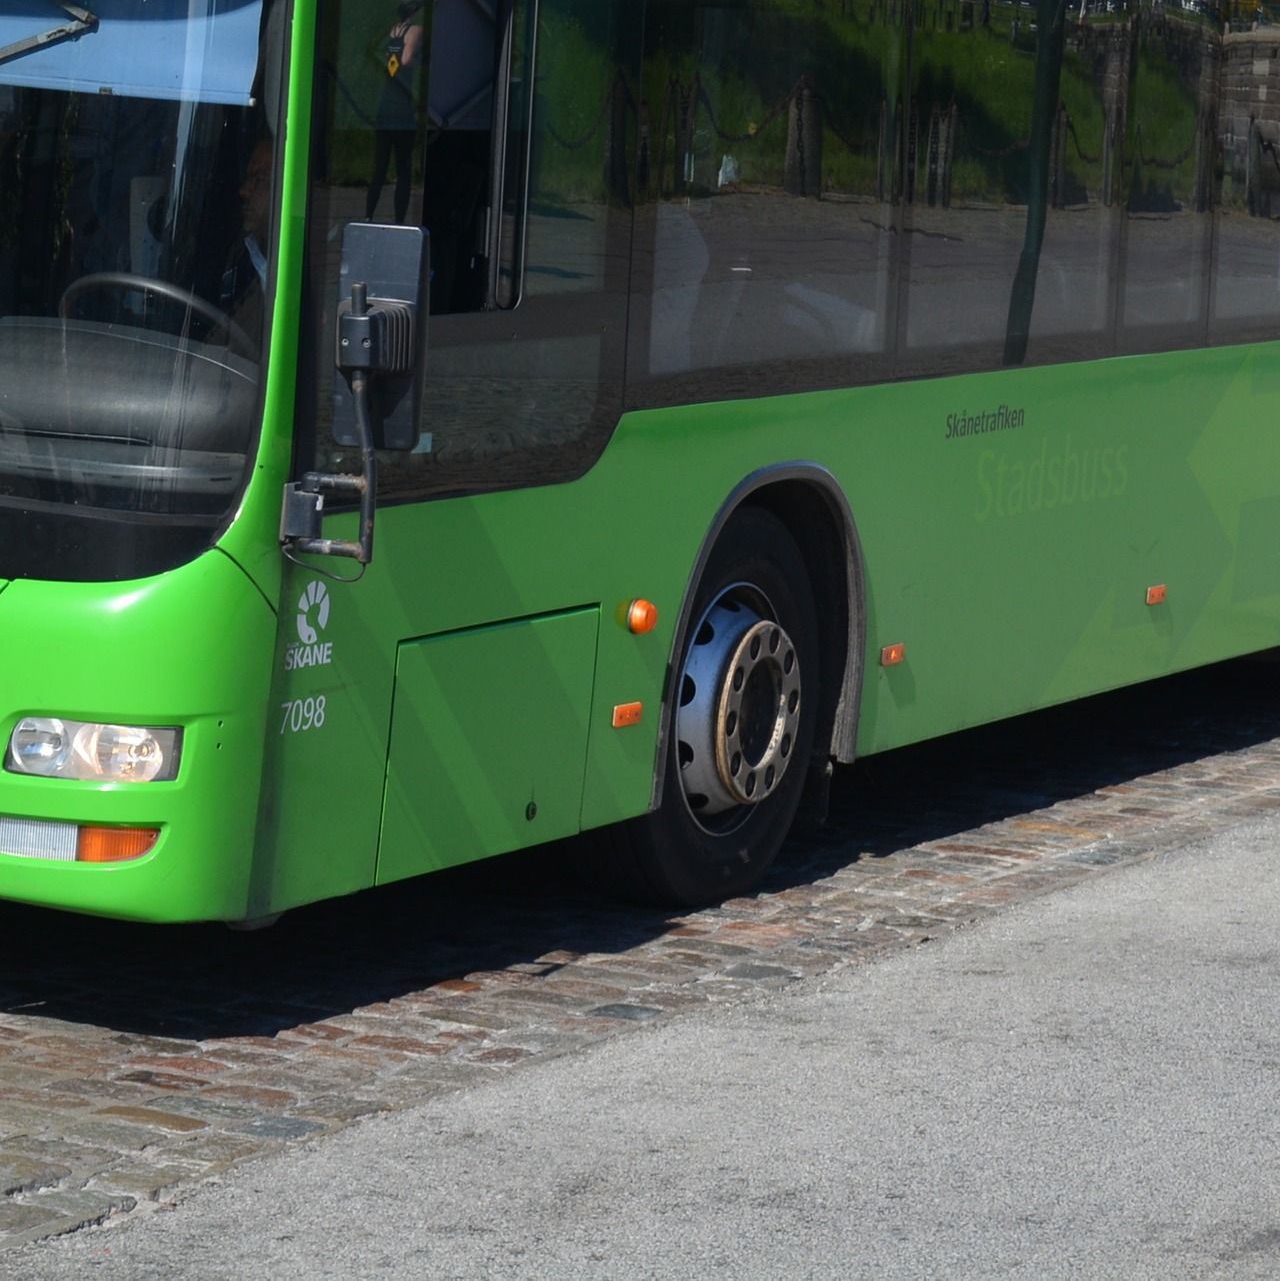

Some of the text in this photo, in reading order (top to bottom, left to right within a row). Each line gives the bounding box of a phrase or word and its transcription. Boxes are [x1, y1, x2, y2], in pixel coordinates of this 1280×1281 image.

[945, 404, 1025, 439] Skånetrafiken
[973, 433, 1129, 523] Stadsbuss
[280, 694, 326, 735] 7098
